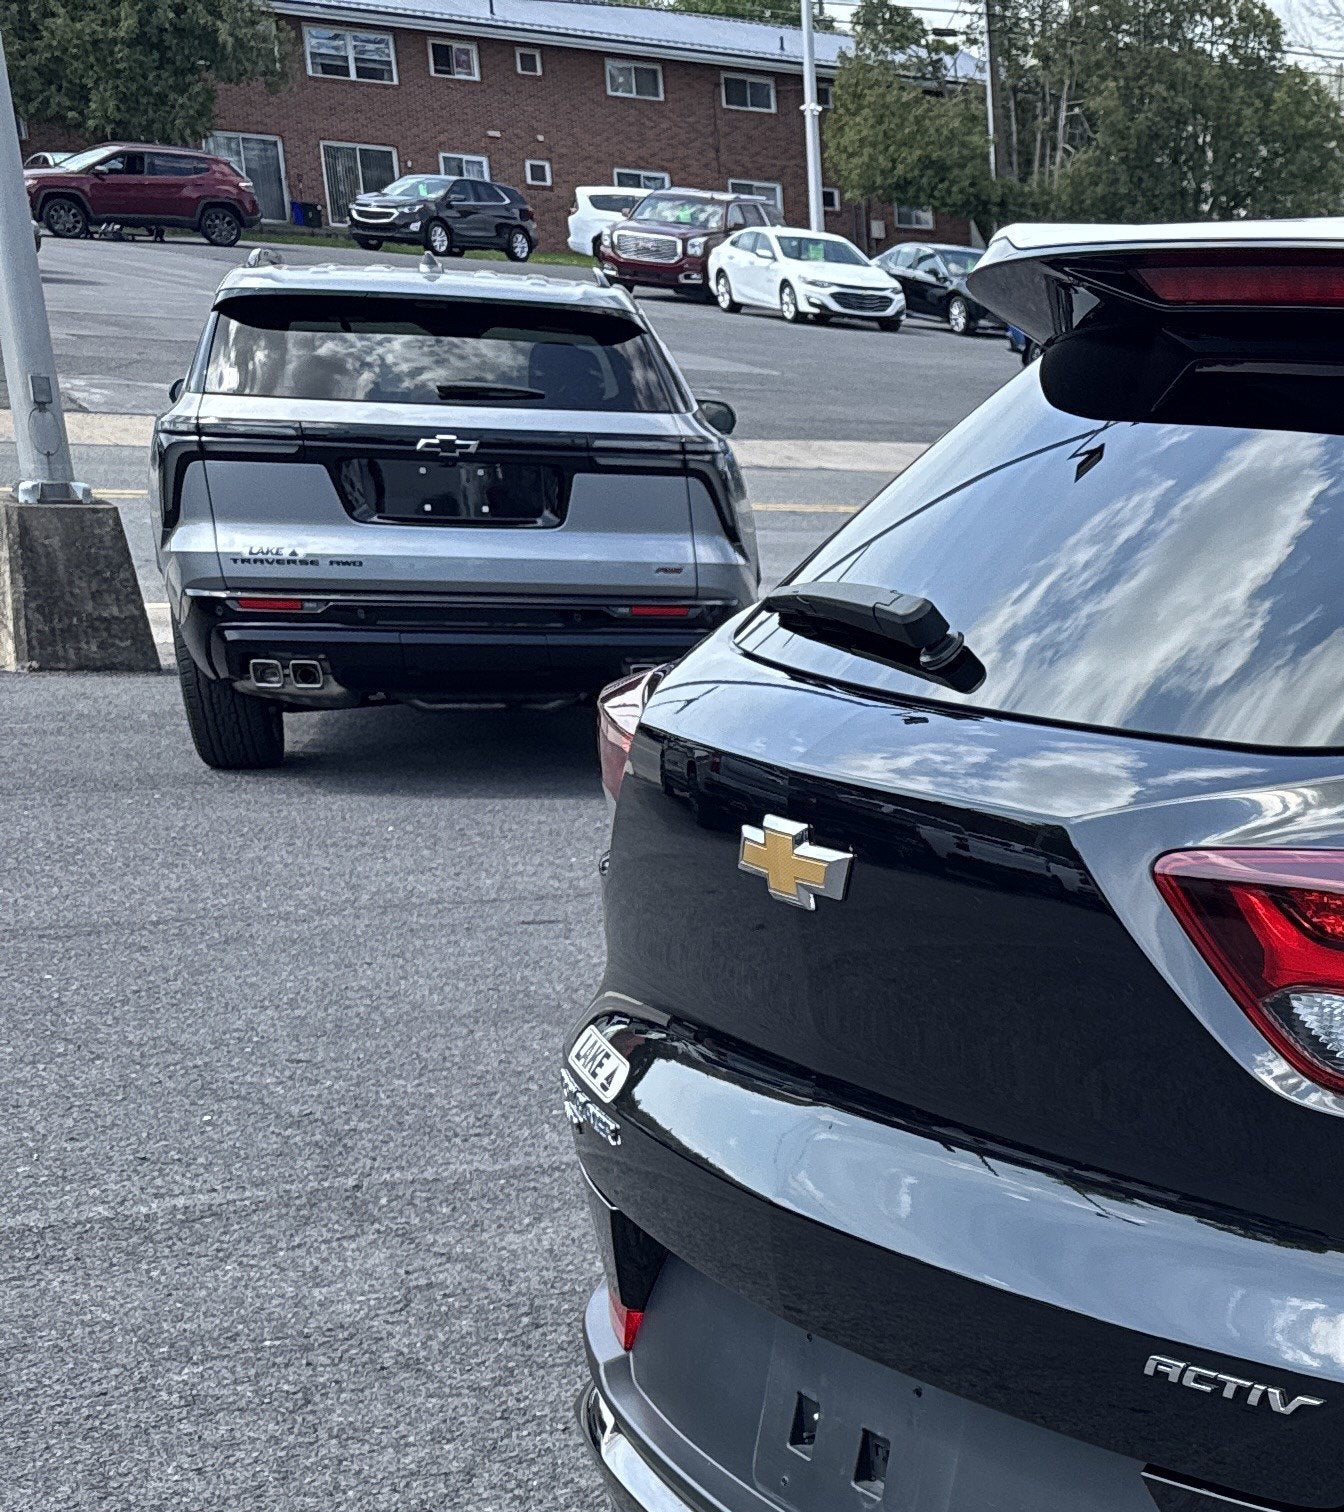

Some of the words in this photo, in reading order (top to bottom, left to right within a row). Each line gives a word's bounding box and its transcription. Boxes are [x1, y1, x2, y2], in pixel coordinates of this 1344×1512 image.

[230, 557, 320, 567] TRAVERSE
[248, 546, 284, 556] LAKE
[574, 1033, 612, 1080] LAKE
[1143, 1354, 1327, 1416] ACTIV
